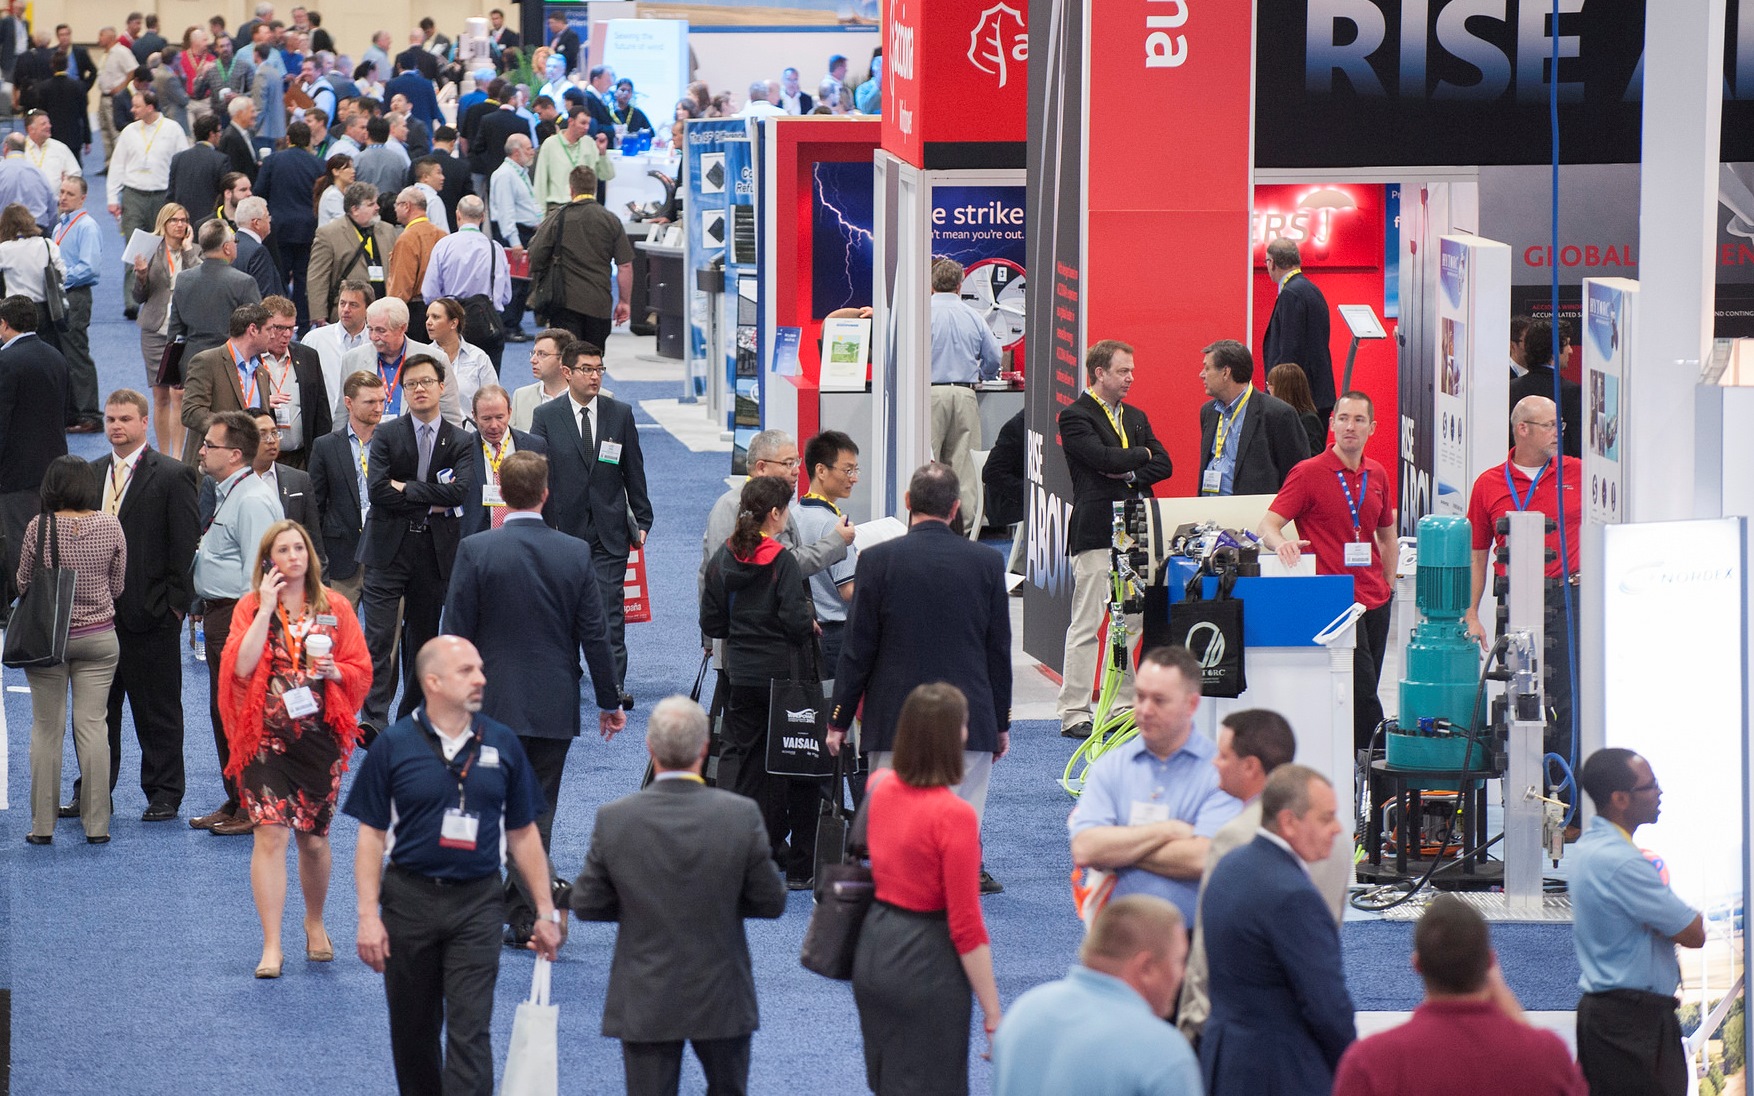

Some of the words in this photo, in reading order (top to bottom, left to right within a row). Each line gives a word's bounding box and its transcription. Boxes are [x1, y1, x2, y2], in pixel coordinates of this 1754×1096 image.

[1305, 0, 1586, 99] RISE
[953, 201, 1024, 225] strike
[942, 231, 970, 239] mean
[972, 230, 1002, 242] you're
[1005, 231, 1024, 239] out.
[1027, 429, 1044, 485] RISE
[1026, 482, 1074, 599] ABOV
[782, 736, 819, 751] VAISALA
